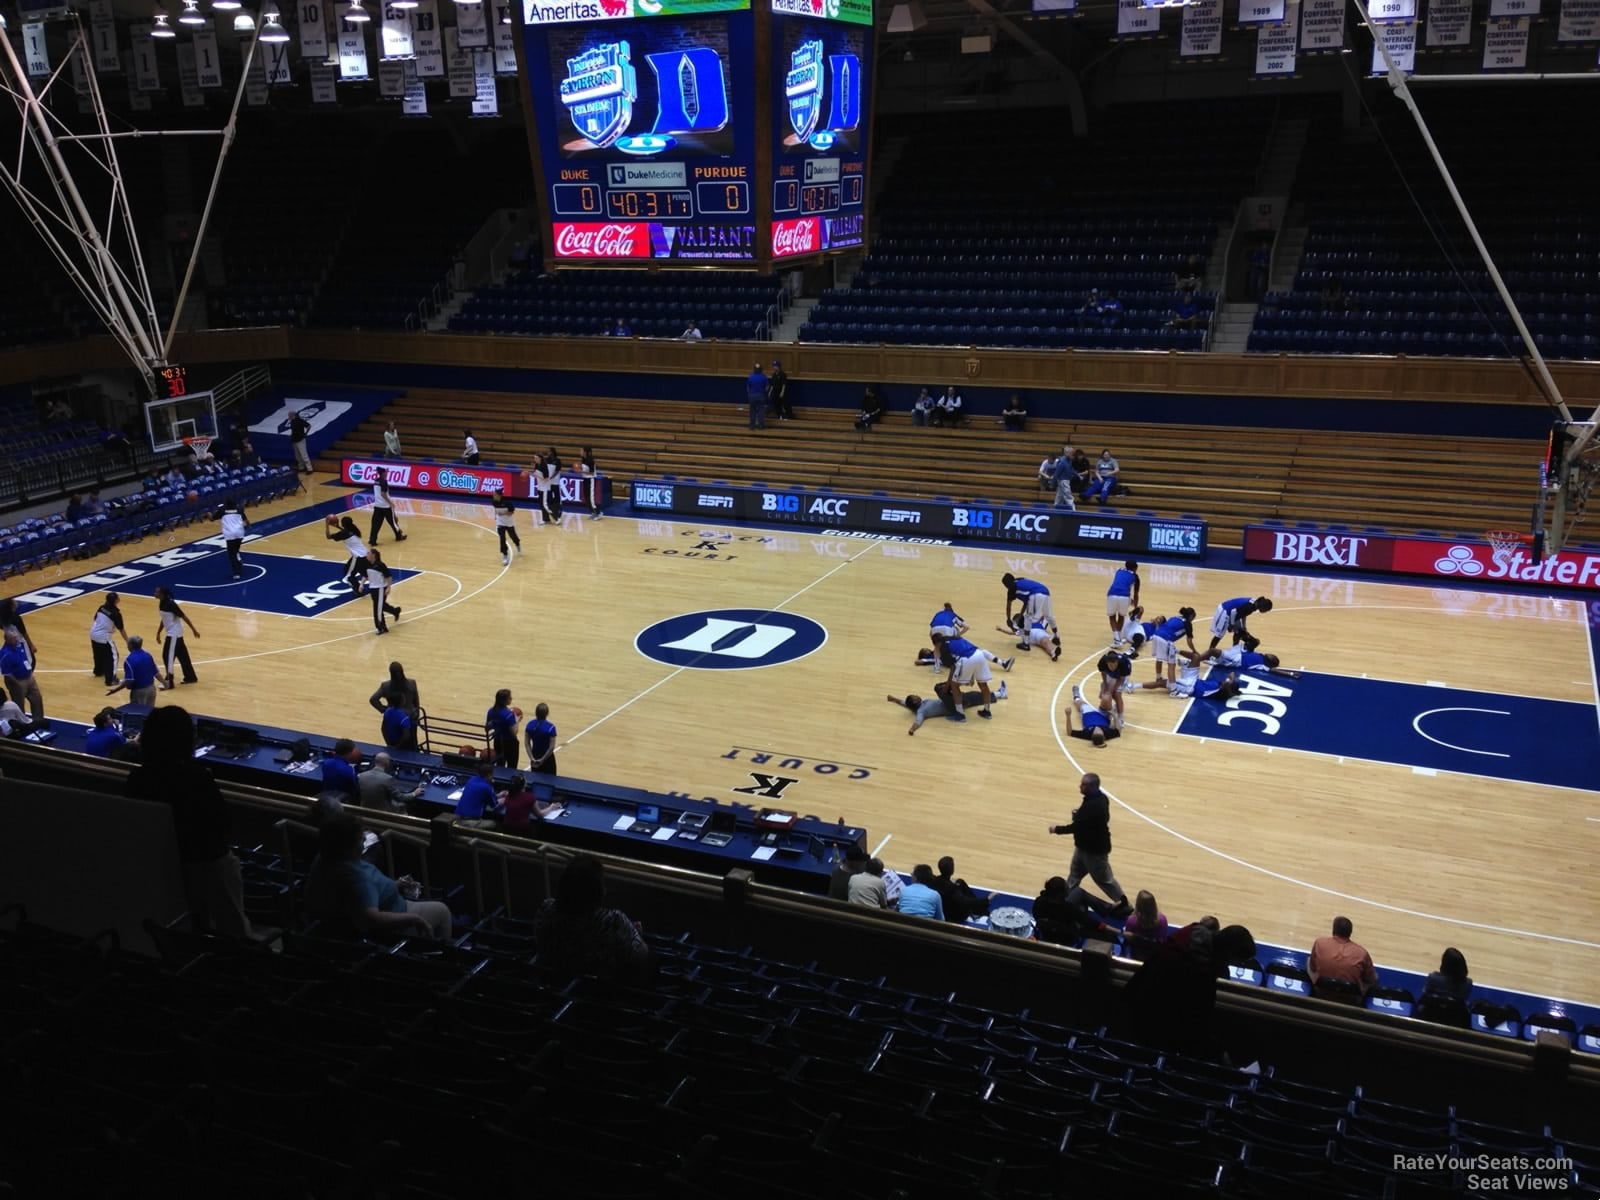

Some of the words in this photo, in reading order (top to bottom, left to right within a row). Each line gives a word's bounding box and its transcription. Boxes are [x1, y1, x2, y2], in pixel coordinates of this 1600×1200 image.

[303, 4, 318, 23] 10
[1383, 4, 1401, 12] 1990
[560, 169, 590, 181] DUKE
[627, 170, 684, 180] DukeMedicine
[694, 167, 748, 178] PURDUE
[581, 187, 594, 211] 0
[726, 185, 739, 210] 0
[168, 377, 185, 397] 30
[418, 472, 430, 486] @
[439, 470, 479, 492] O'Reilly
[483, 477, 504, 486] AUTO
[636, 488, 672, 504] DICK'S
[698, 494, 734, 508] ESPN
[809, 497, 849, 516] ACC
[881, 508, 921, 523] ESPN
[1004, 513, 1050, 533] ACC
[1078, 524, 1123, 540] ESPN
[1151, 528, 1199, 547] DICK'S
[644, 548, 738, 561] COURT
[1272, 531, 1367, 567] BB&T
[1217, 674, 1293, 735] ACC
[721, 749, 870, 780] COURT
[733, 772, 799, 799] K
